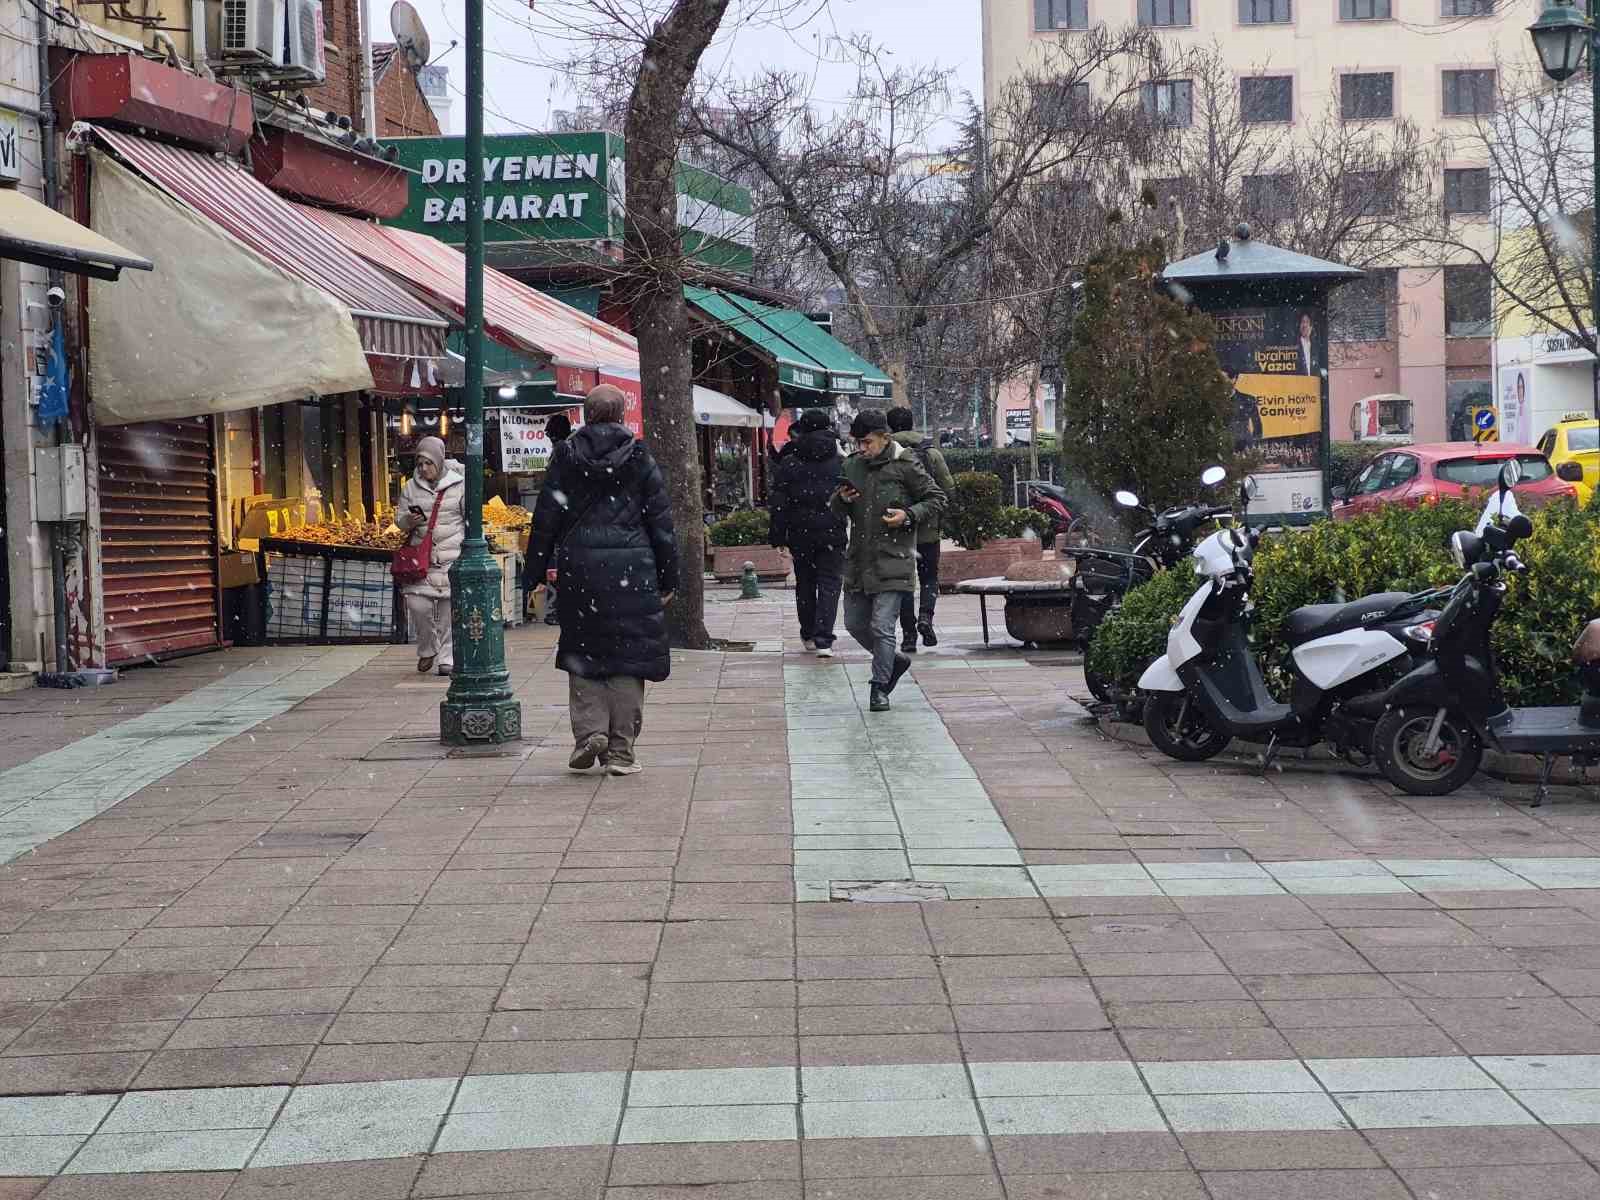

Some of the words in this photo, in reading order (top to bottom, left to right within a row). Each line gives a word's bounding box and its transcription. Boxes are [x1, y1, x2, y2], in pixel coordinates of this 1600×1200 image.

[482, 153, 599, 182] YEMEN
[1257, 394, 1285, 406] Elvin
[1260, 405, 1306, 417] Ganiyev
[518, 430, 545, 441] 100
[523, 447, 548, 455] AYDA
